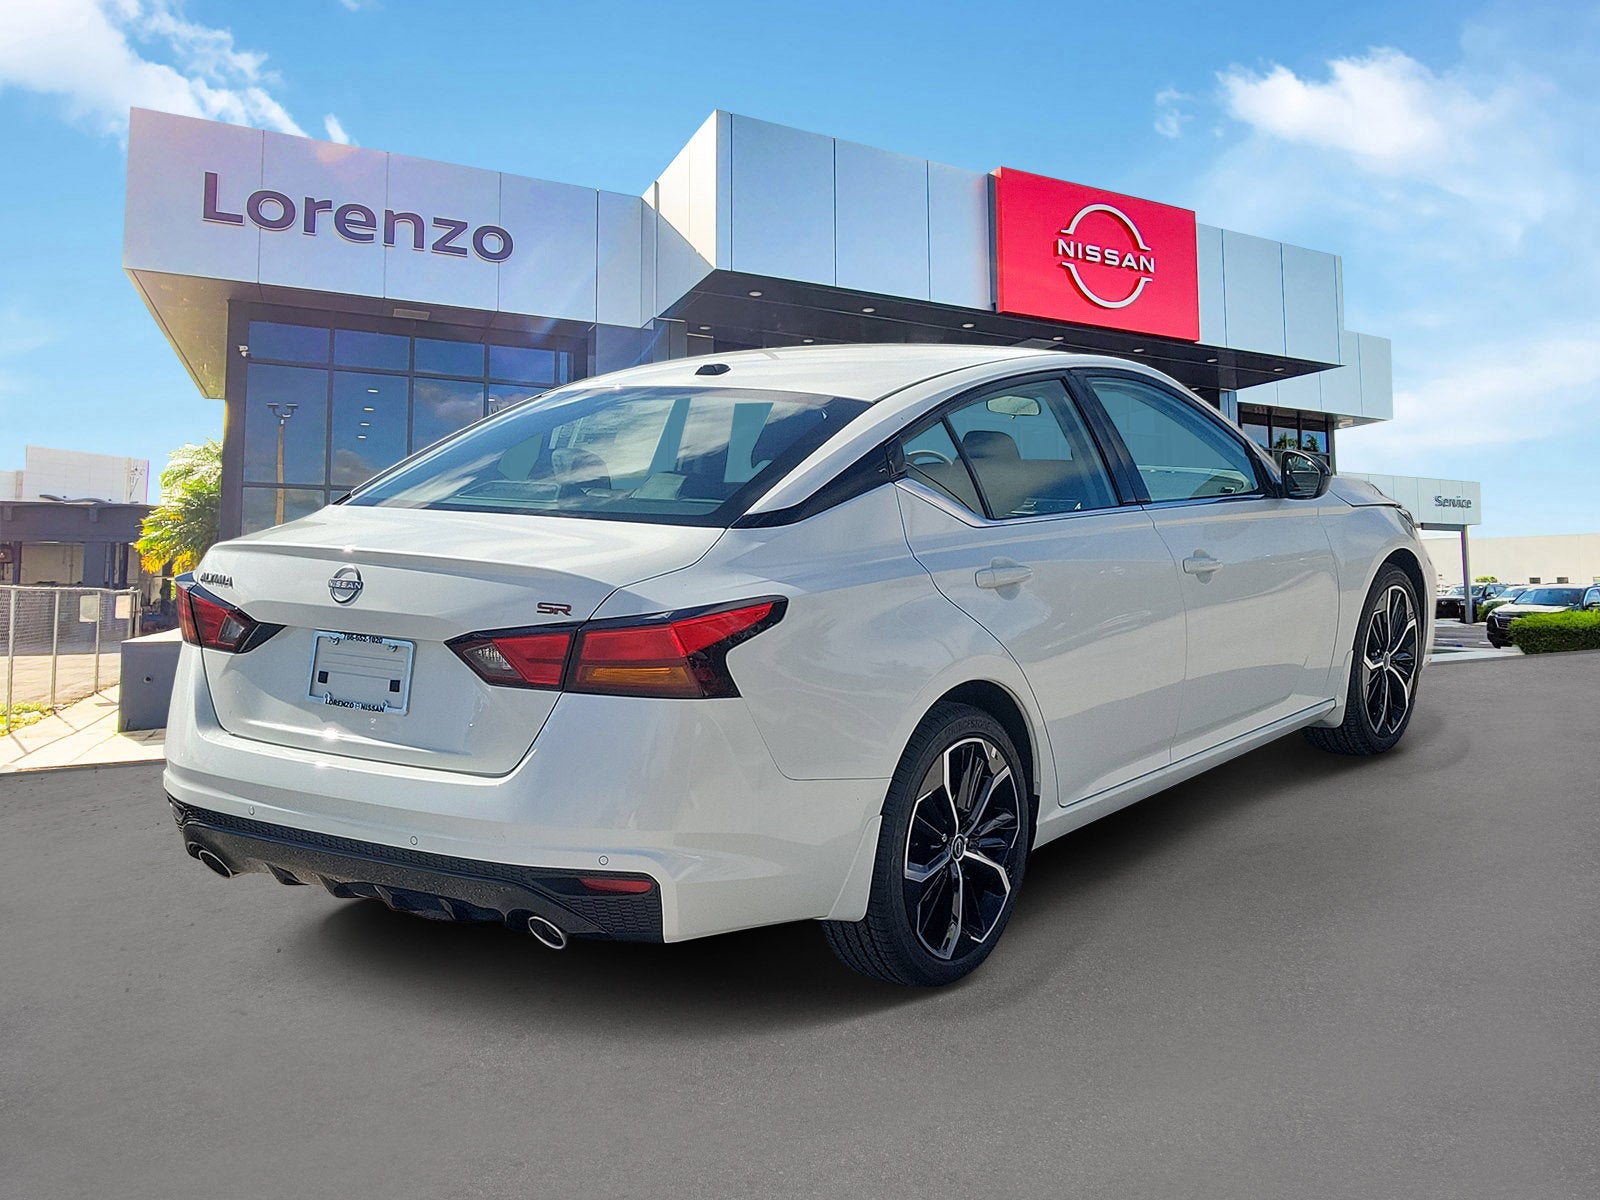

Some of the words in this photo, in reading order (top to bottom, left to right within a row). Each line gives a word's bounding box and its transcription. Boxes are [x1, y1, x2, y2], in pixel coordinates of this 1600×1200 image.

[202, 171, 514, 262] Lorenzo
[1057, 238, 1155, 273] NISSAN
[1433, 495, 1472, 509] Service
[329, 579, 362, 590] NISSAN
[536, 602, 572, 616] SR
[325, 698, 355, 709] LORENZO
[360, 703, 385, 713] NISSAN
